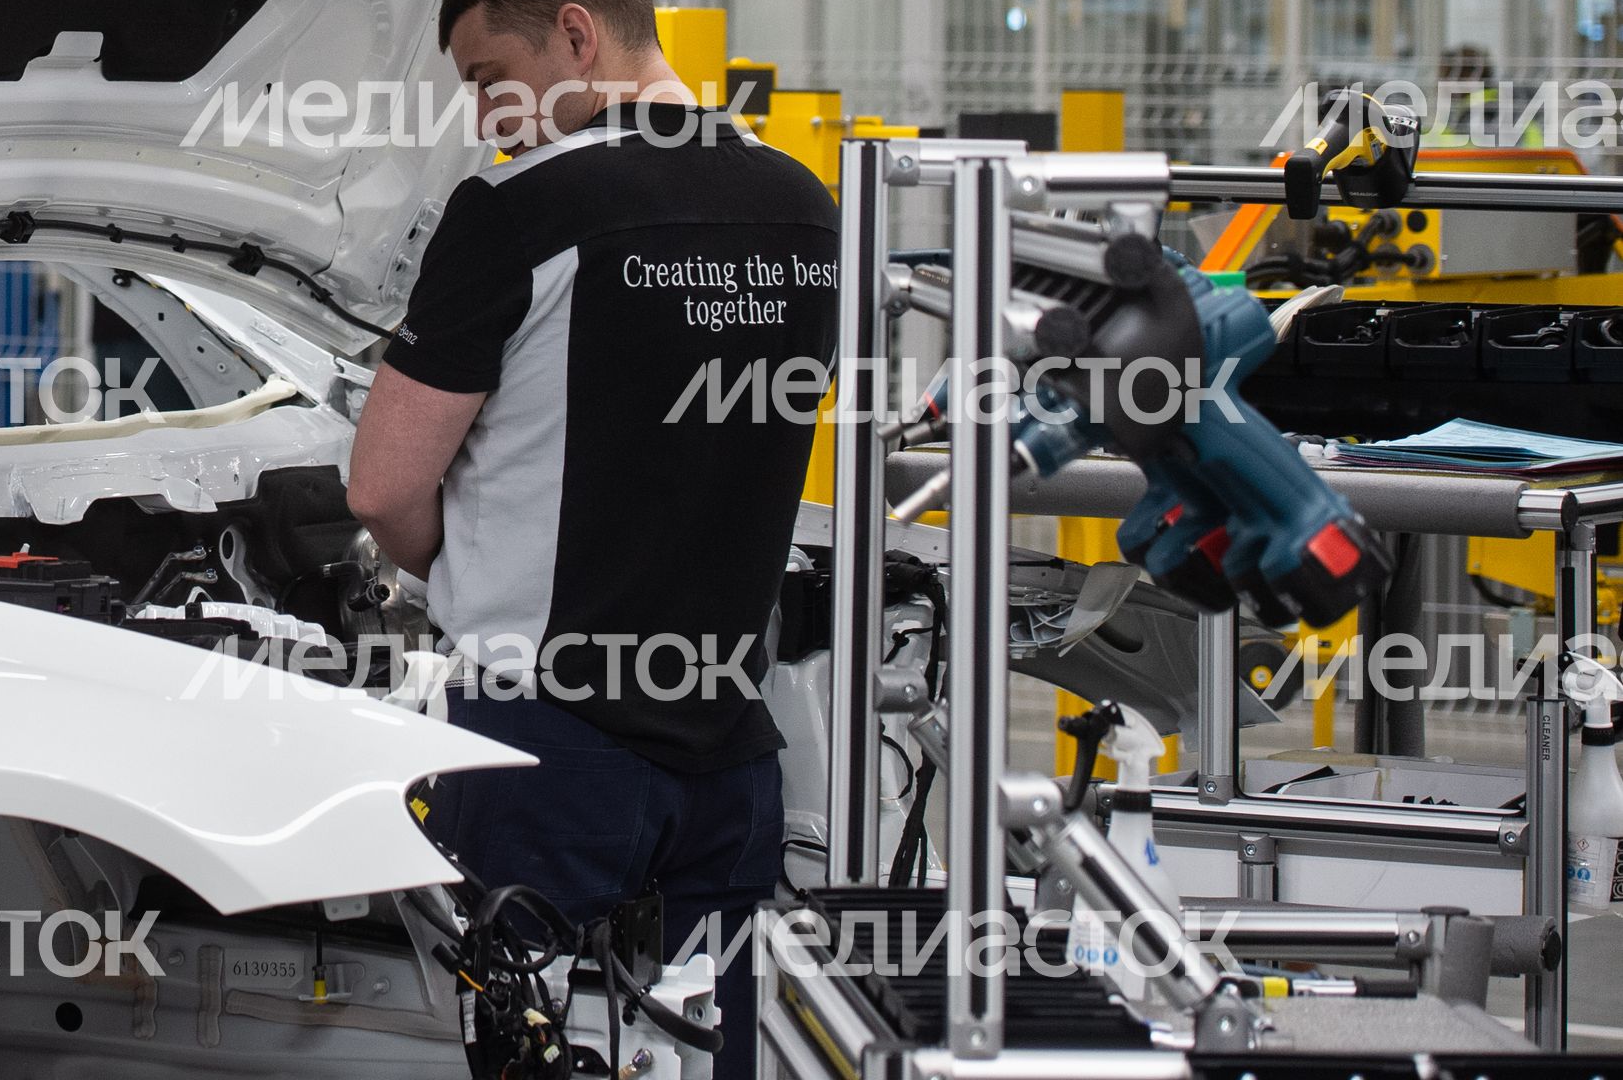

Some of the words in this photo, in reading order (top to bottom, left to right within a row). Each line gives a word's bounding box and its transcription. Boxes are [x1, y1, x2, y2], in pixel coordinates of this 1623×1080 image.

[623, 255, 738, 293] Creating
[745, 255, 784, 286] the
[792, 255, 839, 289] best
[684, 293, 787, 332] together
[1542, 714, 1551, 761] CLEANER
[233, 960, 296, 978] 6139355
